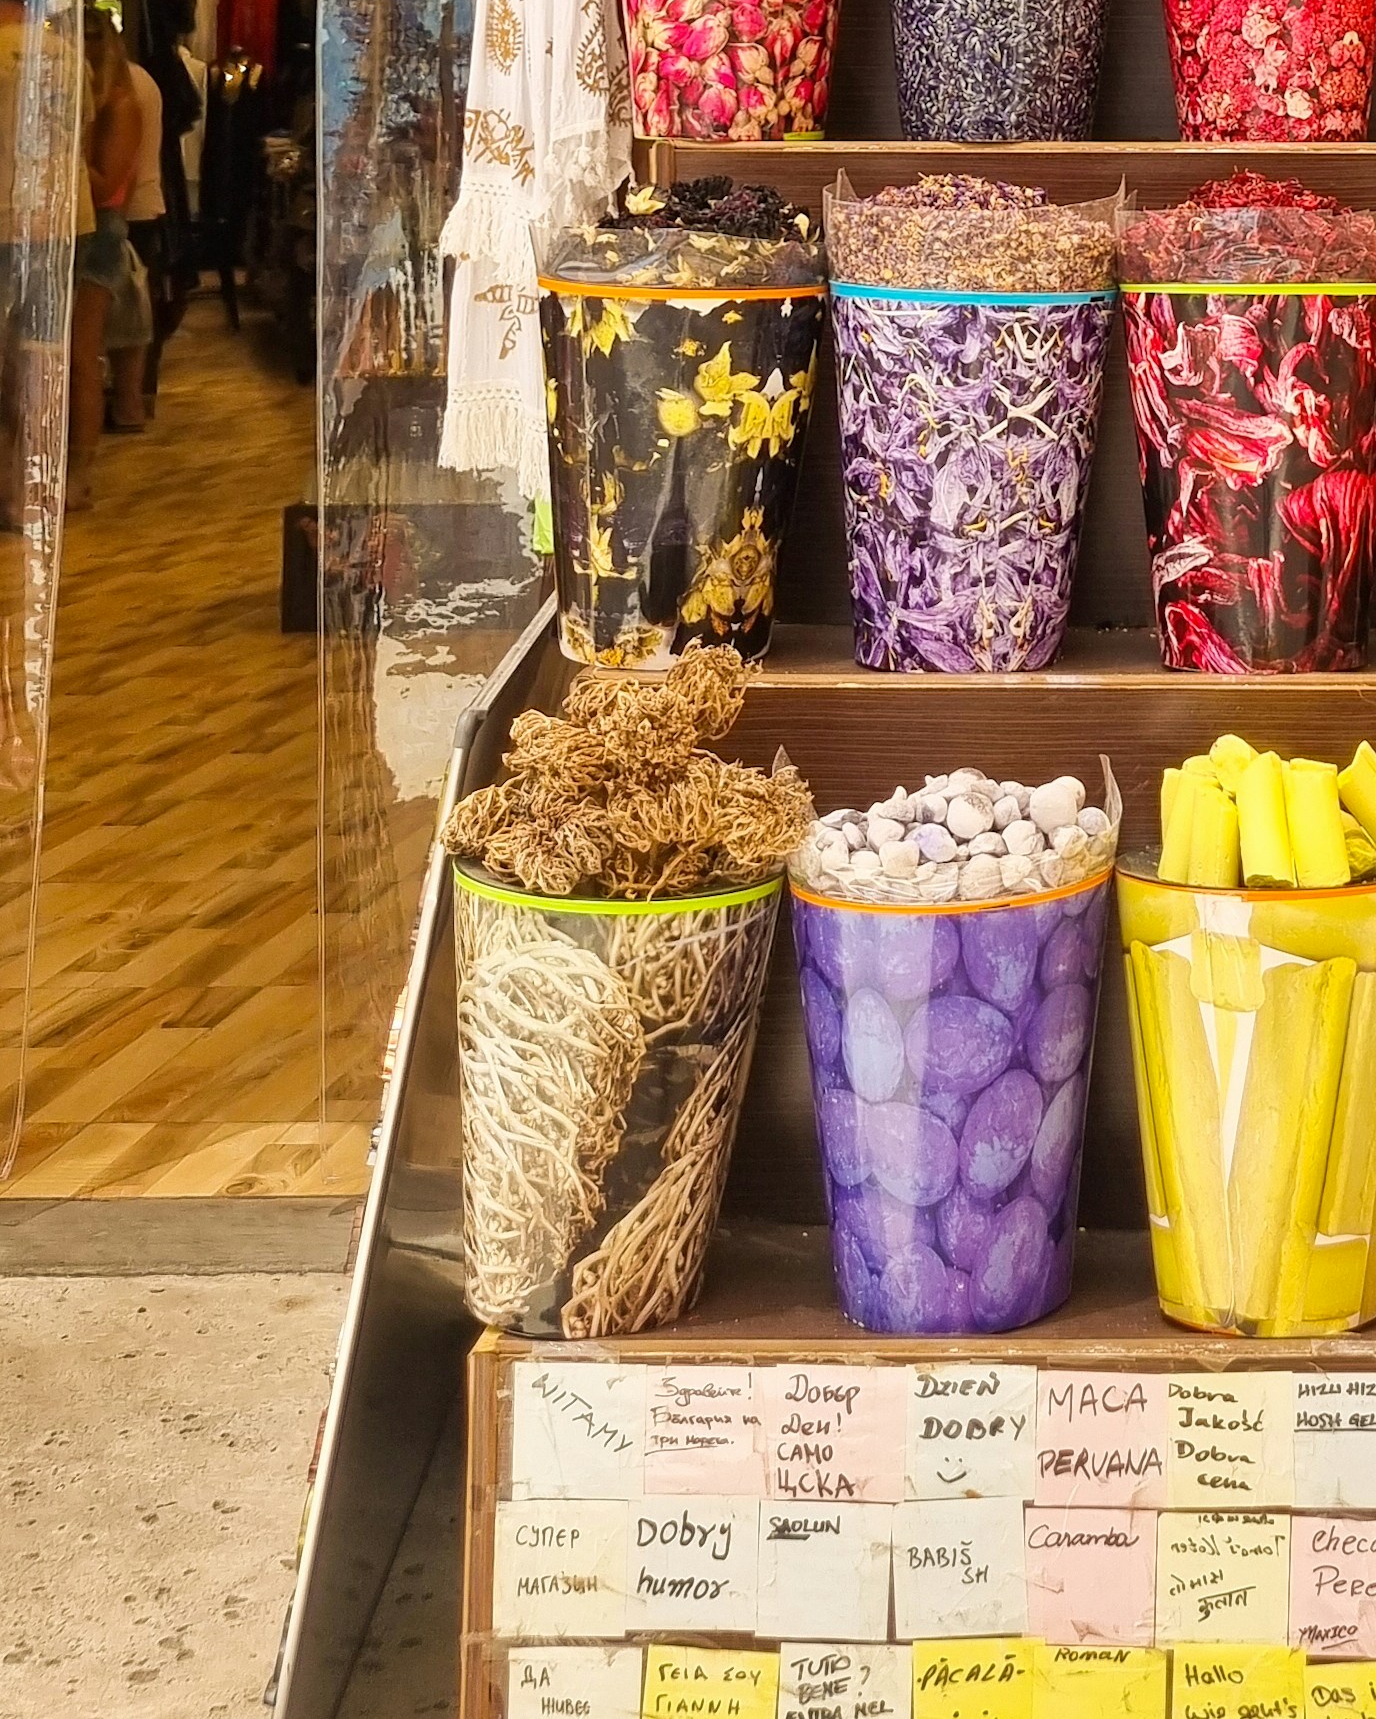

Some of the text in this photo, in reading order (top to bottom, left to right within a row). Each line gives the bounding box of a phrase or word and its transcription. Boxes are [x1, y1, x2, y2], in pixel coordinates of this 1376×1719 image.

[1048, 1383, 1147, 1423] MACA
[1168, 1383, 1238, 1403] Dobra
[919, 1414, 1026, 1441] DOBRY
[777, 1442, 833, 1464] САМО
[1038, 1447, 1163, 1480] PERUANA
[1174, 1440, 1255, 1464] Dobra
[777, 1467, 856, 1498] ЦСКА
[515, 1525, 580, 1548] СУПЕР
[1028, 1524, 1140, 1549] Caramba
[908, 1540, 973, 1569] BABIŠ
[636, 1566, 730, 1599] humor
[961, 1565, 988, 1584] SH
[520, 1665, 550, 1689] ДА
[1185, 1663, 1244, 1687] Hallo
[1311, 1685, 1356, 1707] Das
